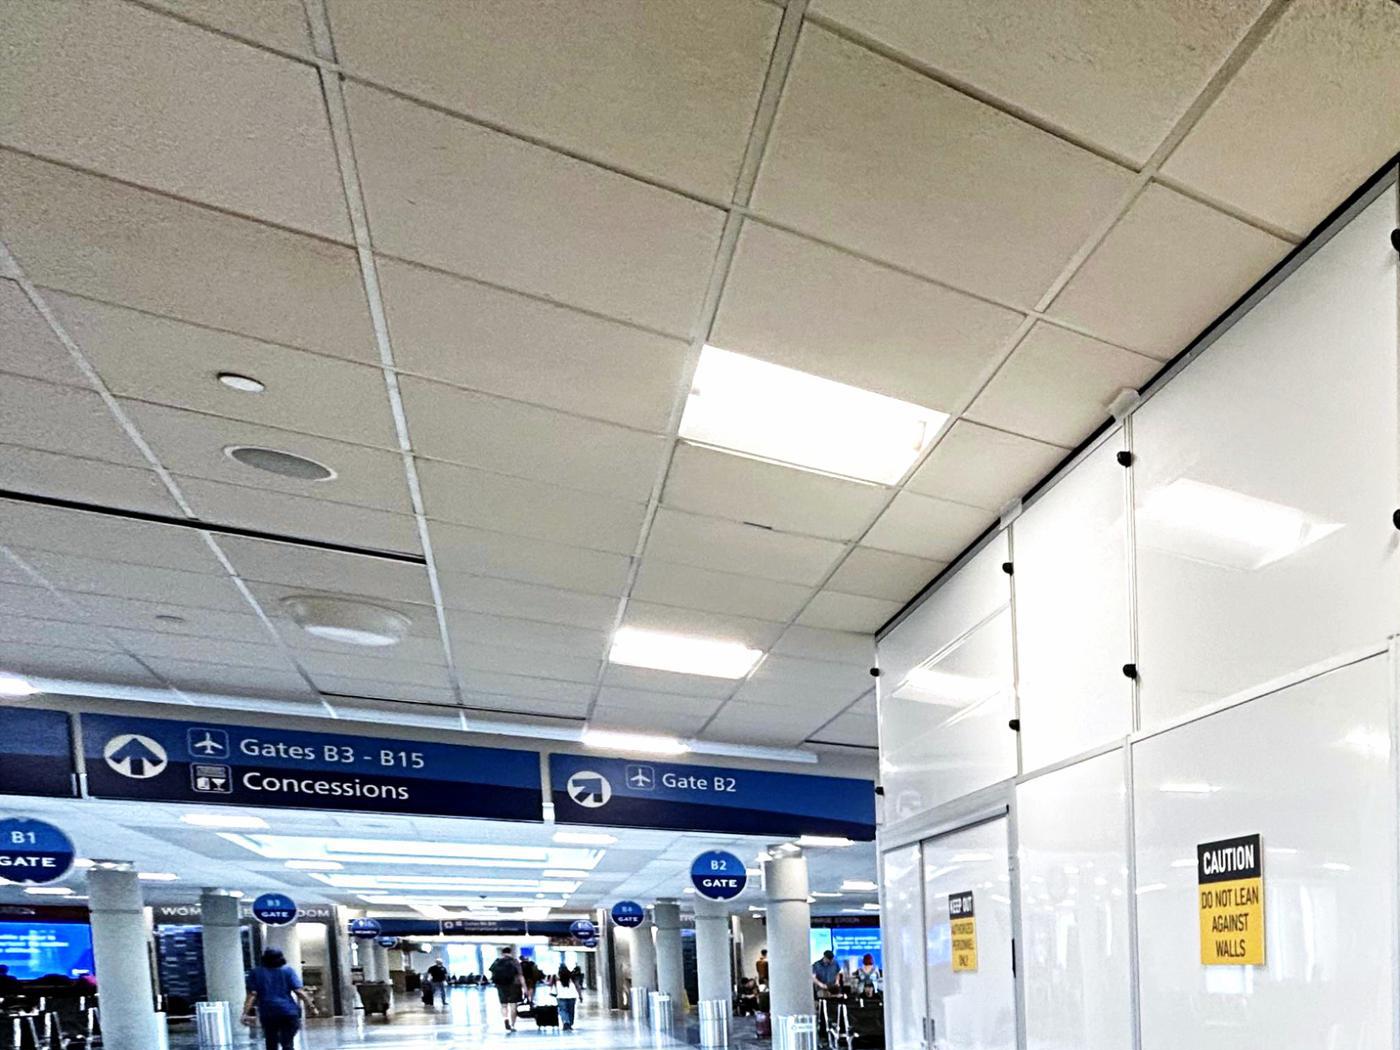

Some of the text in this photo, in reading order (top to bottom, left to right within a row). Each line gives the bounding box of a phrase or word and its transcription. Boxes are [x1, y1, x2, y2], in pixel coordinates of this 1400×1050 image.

[240, 738, 315, 760] Gates
[323, 745, 355, 763] B3
[380, 750, 425, 769] B15
[242, 772, 409, 799] Concessions
[662, 773, 737, 792] Gate B2
[11, 831, 36, 844] B1
[0, 856, 56, 867] GATE
[711, 860, 727, 871] B2
[1203, 844, 1255, 875] CAUTION
[702, 879, 738, 887] GATE
[1201, 886, 1259, 909] DO NOT LEAN
[1212, 913, 1249, 932] AGAINST
[1215, 938, 1246, 957] WALLS
